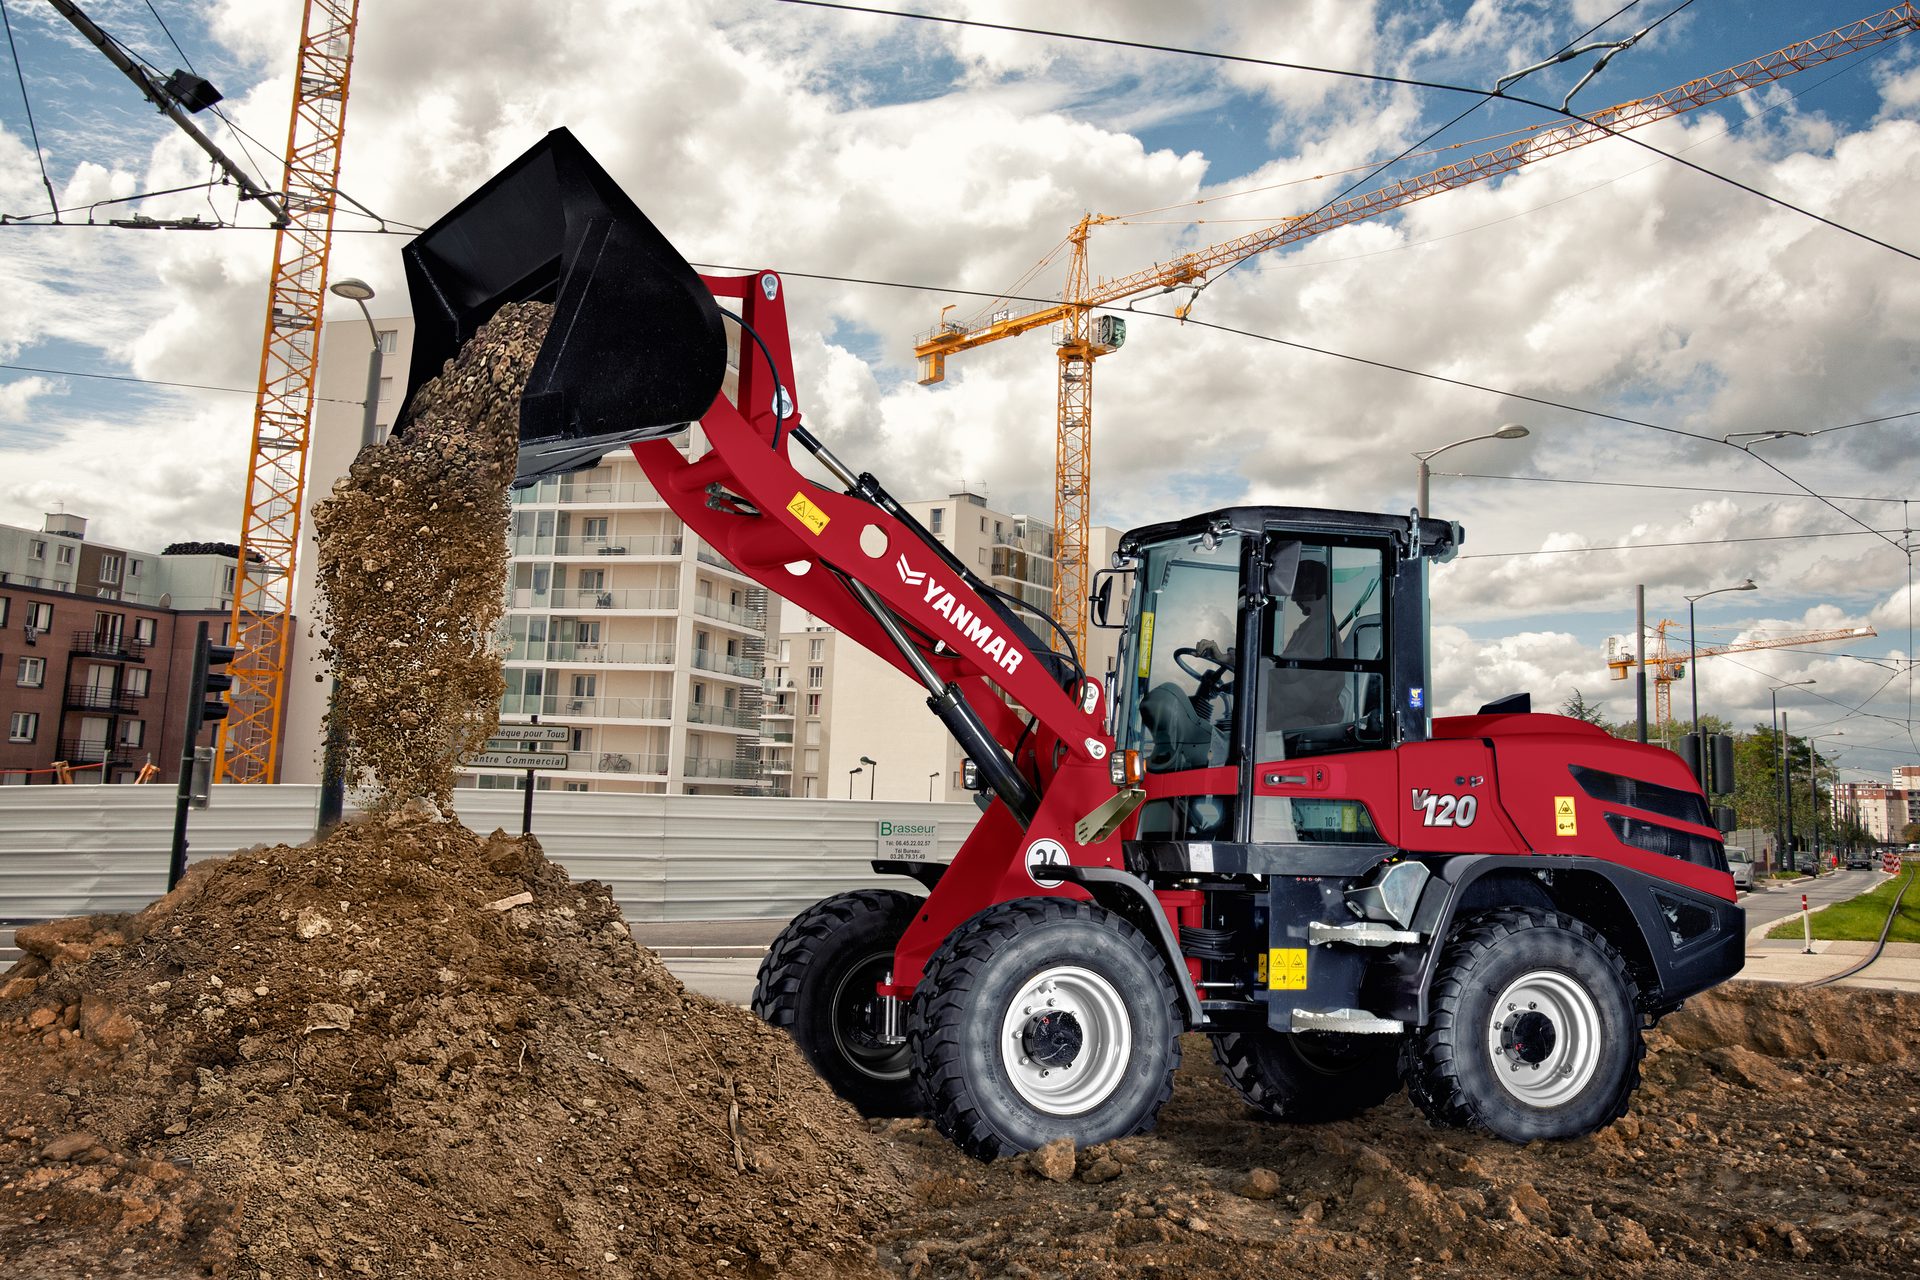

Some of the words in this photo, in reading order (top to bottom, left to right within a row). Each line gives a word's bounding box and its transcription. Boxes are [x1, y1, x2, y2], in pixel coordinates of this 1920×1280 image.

[993, 310, 1008, 322] BEC
[923, 577, 1024, 675] YANMAR
[523, 730, 543, 739] pour
[546, 729, 565, 738] Tous
[505, 755, 565, 766] Commercial
[1411, 788, 1479, 828] V120
[880, 821, 936, 836] Brasseur
